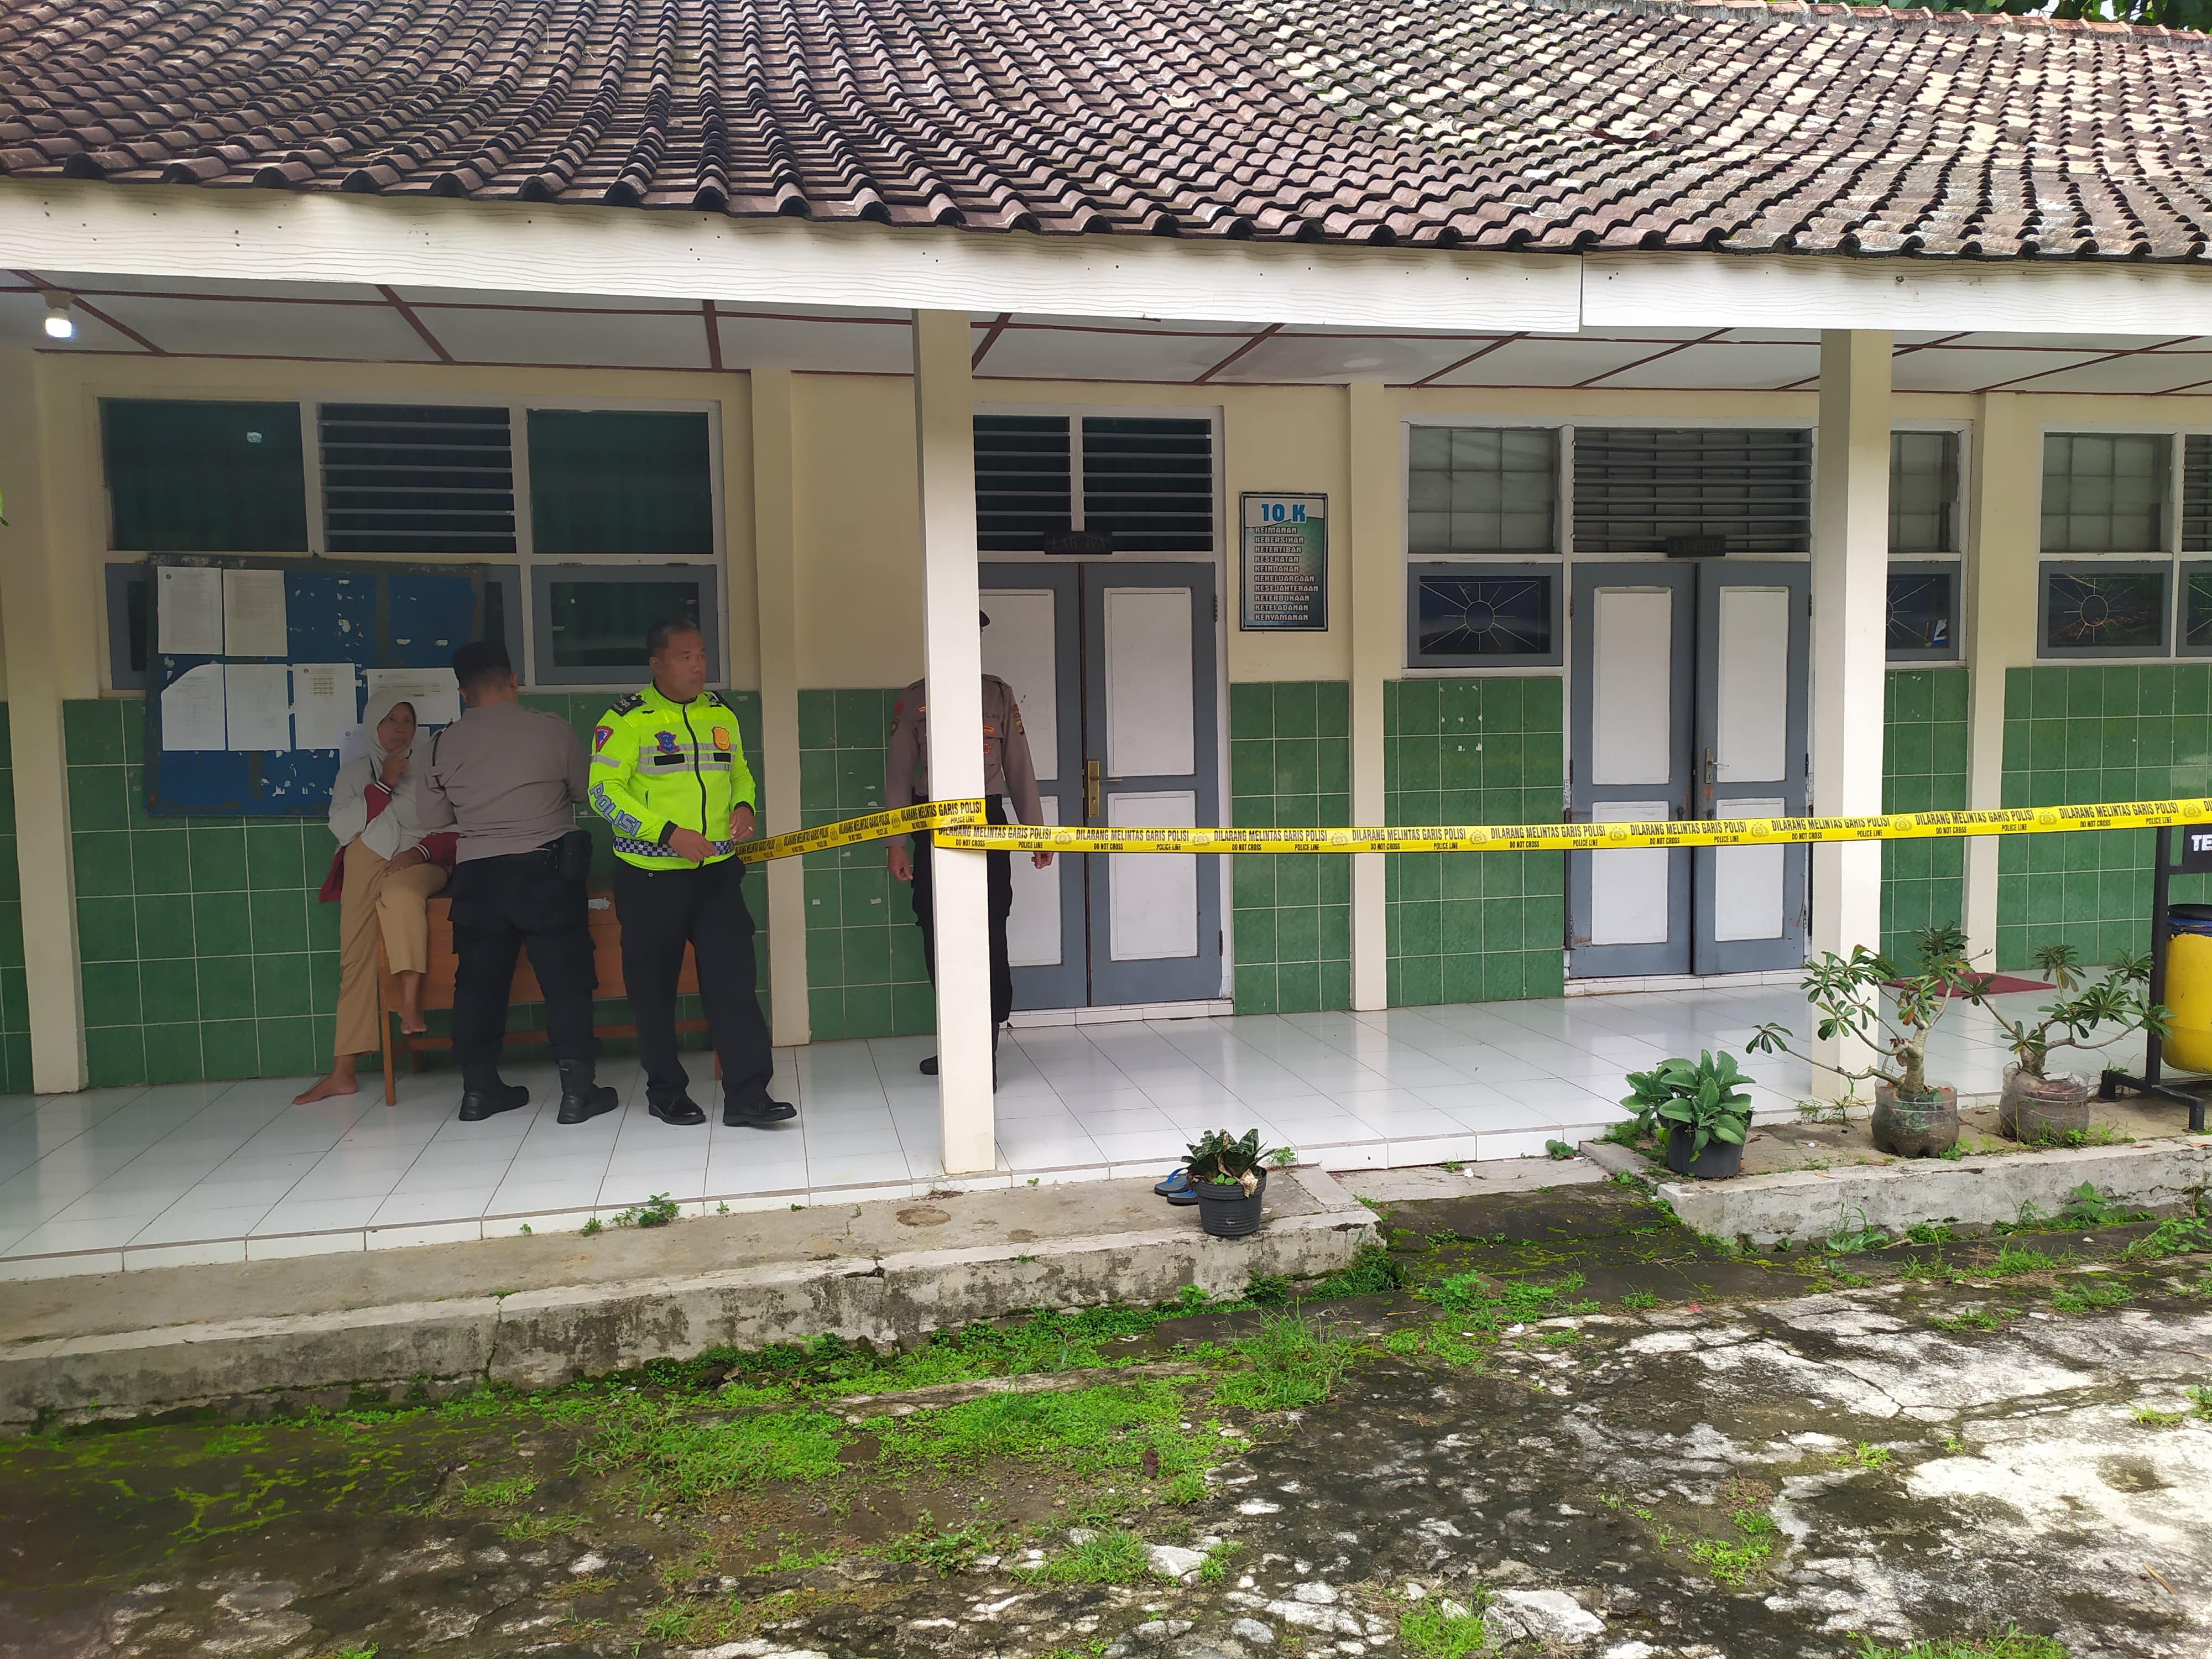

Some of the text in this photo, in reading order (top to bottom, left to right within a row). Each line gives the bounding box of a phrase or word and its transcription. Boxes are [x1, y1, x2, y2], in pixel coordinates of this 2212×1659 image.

[1261, 504, 1307, 522] 10 K
[589, 781, 643, 837] POLISI
[901, 801, 981, 822] DILARANG MELINTAS GARIS POLISI
[2059, 802, 2179, 819] DILARANG MELINTAS GARIS POLISI
[1771, 817, 1890, 831] DILARANG MELINTAS GARIS POLISI
[1914, 809, 2034, 825] DILARANG MELINTAS GARIS POLISI
[938, 825, 1051, 839] DILARANG MELINTAS GARIS POLISI
[1076, 830, 1189, 841] DILARANG MELINTAS GARIS POLISI
[1214, 830, 1327, 841] DILARANG MELINTAS GARIS POLISI
[1352, 828, 1466, 841] DILARANG MELINTAS GARIS POLISI
[1490, 825, 1605, 839] DILARANG MELINTAS GARIS POLISI
[1630, 821, 1747, 836] DILARANG MELINTAS GARIS POLISI
